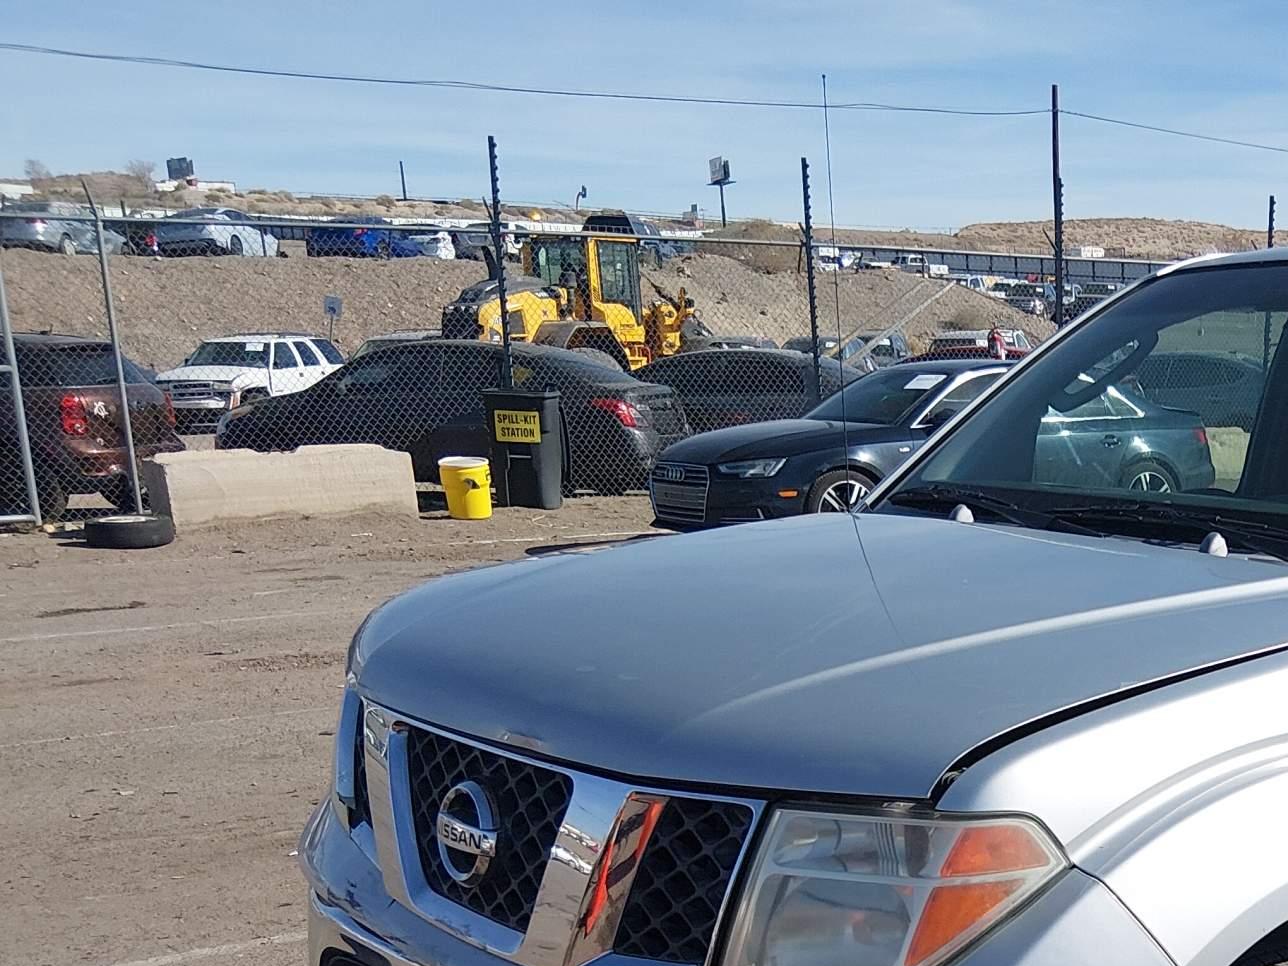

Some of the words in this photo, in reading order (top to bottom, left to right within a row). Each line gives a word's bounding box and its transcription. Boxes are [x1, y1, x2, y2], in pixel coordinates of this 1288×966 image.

[496, 414, 537, 425] SPILL-KIT
[500, 427, 535, 438] STATION
[439, 822, 481, 850] ISSAN
